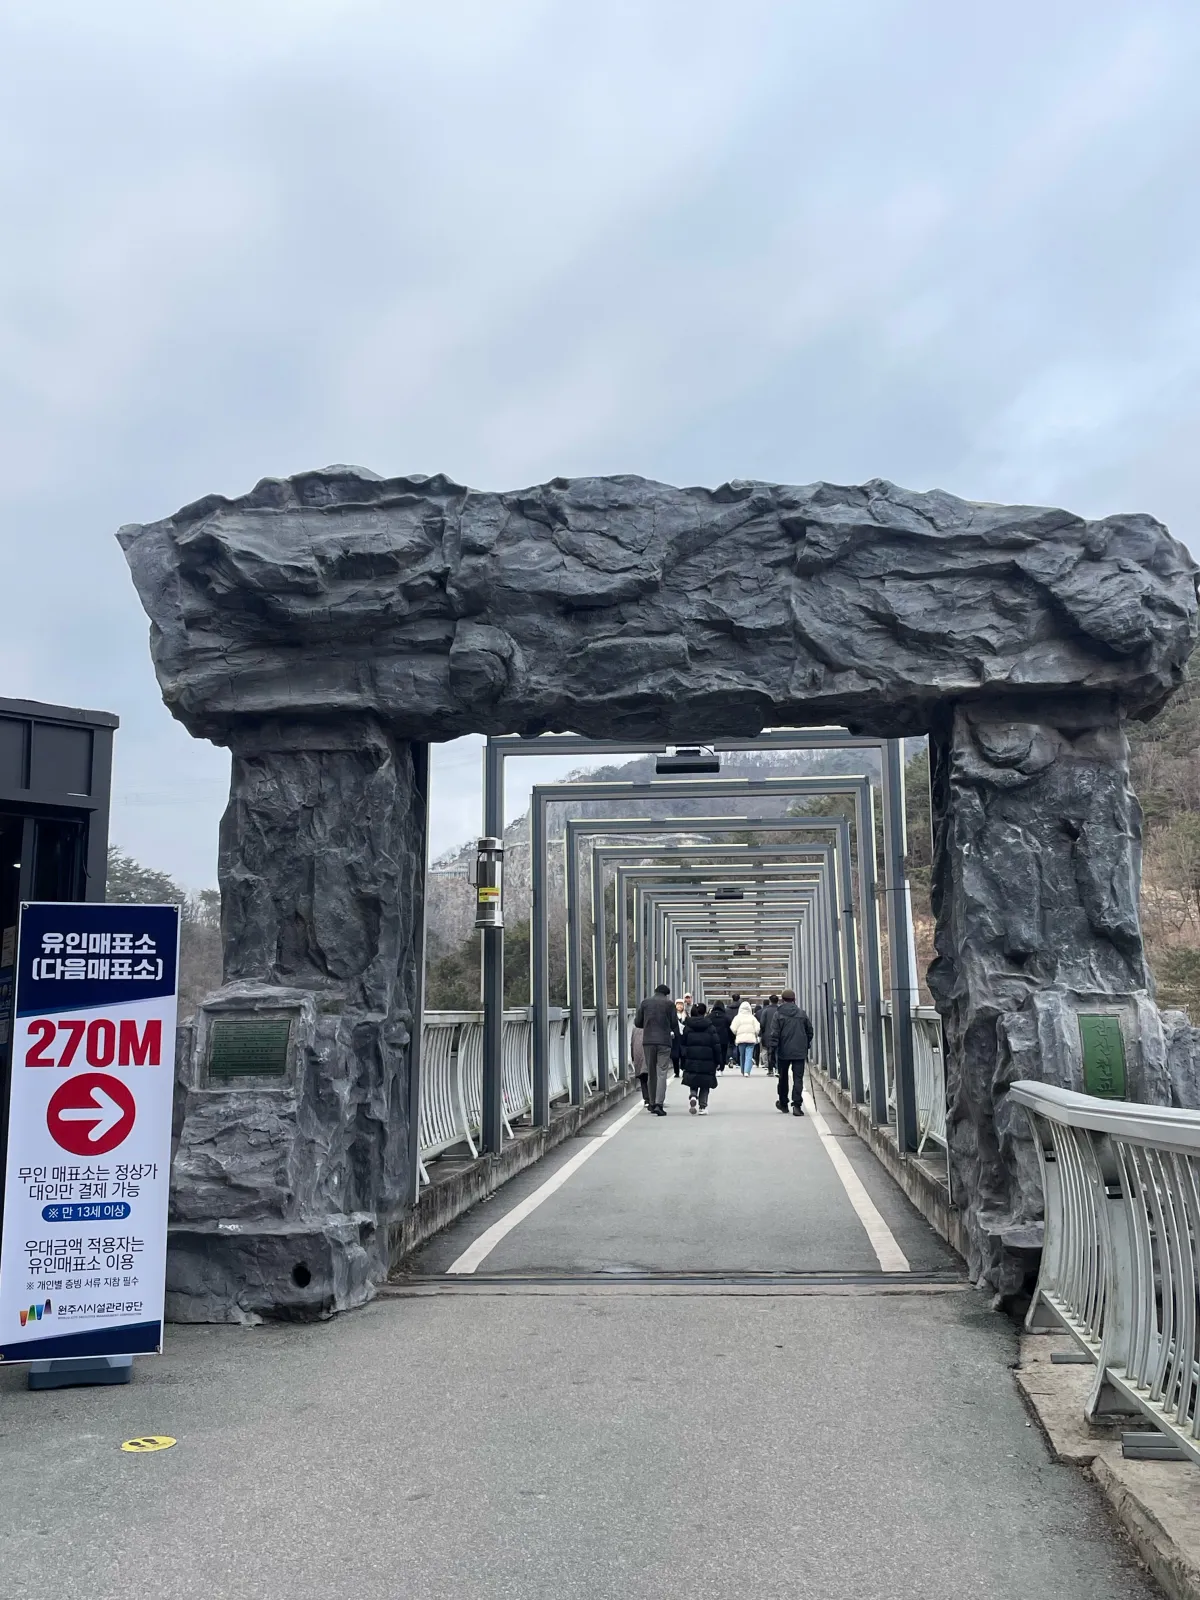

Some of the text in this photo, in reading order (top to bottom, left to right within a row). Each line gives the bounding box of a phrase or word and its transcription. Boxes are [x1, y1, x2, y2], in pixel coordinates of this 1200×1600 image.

[41, 933, 156, 954] 유인매표소
[32, 958, 163, 981] (다음매표소)
[25, 1019, 162, 1067] 270M
[18, 1163, 158, 1184] 무인 매표소는 정상가
[29, 1182, 140, 1200] 대인만 결제 가능
[62, 1207, 73, 1218] 만
[77, 1206, 100, 1218] 13세
[104, 1205, 125, 1217] 이상
[24, 1236, 144, 1257] 우대금액 적용자는
[28, 1254, 134, 1275] 유인매표소 이용
[37, 1280, 62, 1290] 개인별
[65, 1279, 82, 1289] 증빙
[84, 1278, 101, 1288] 서류
[103, 1277, 120, 1287] 지참
[123, 1276, 139, 1286] 필수
[58, 1302, 143, 1315] 원주시시설관리공단
